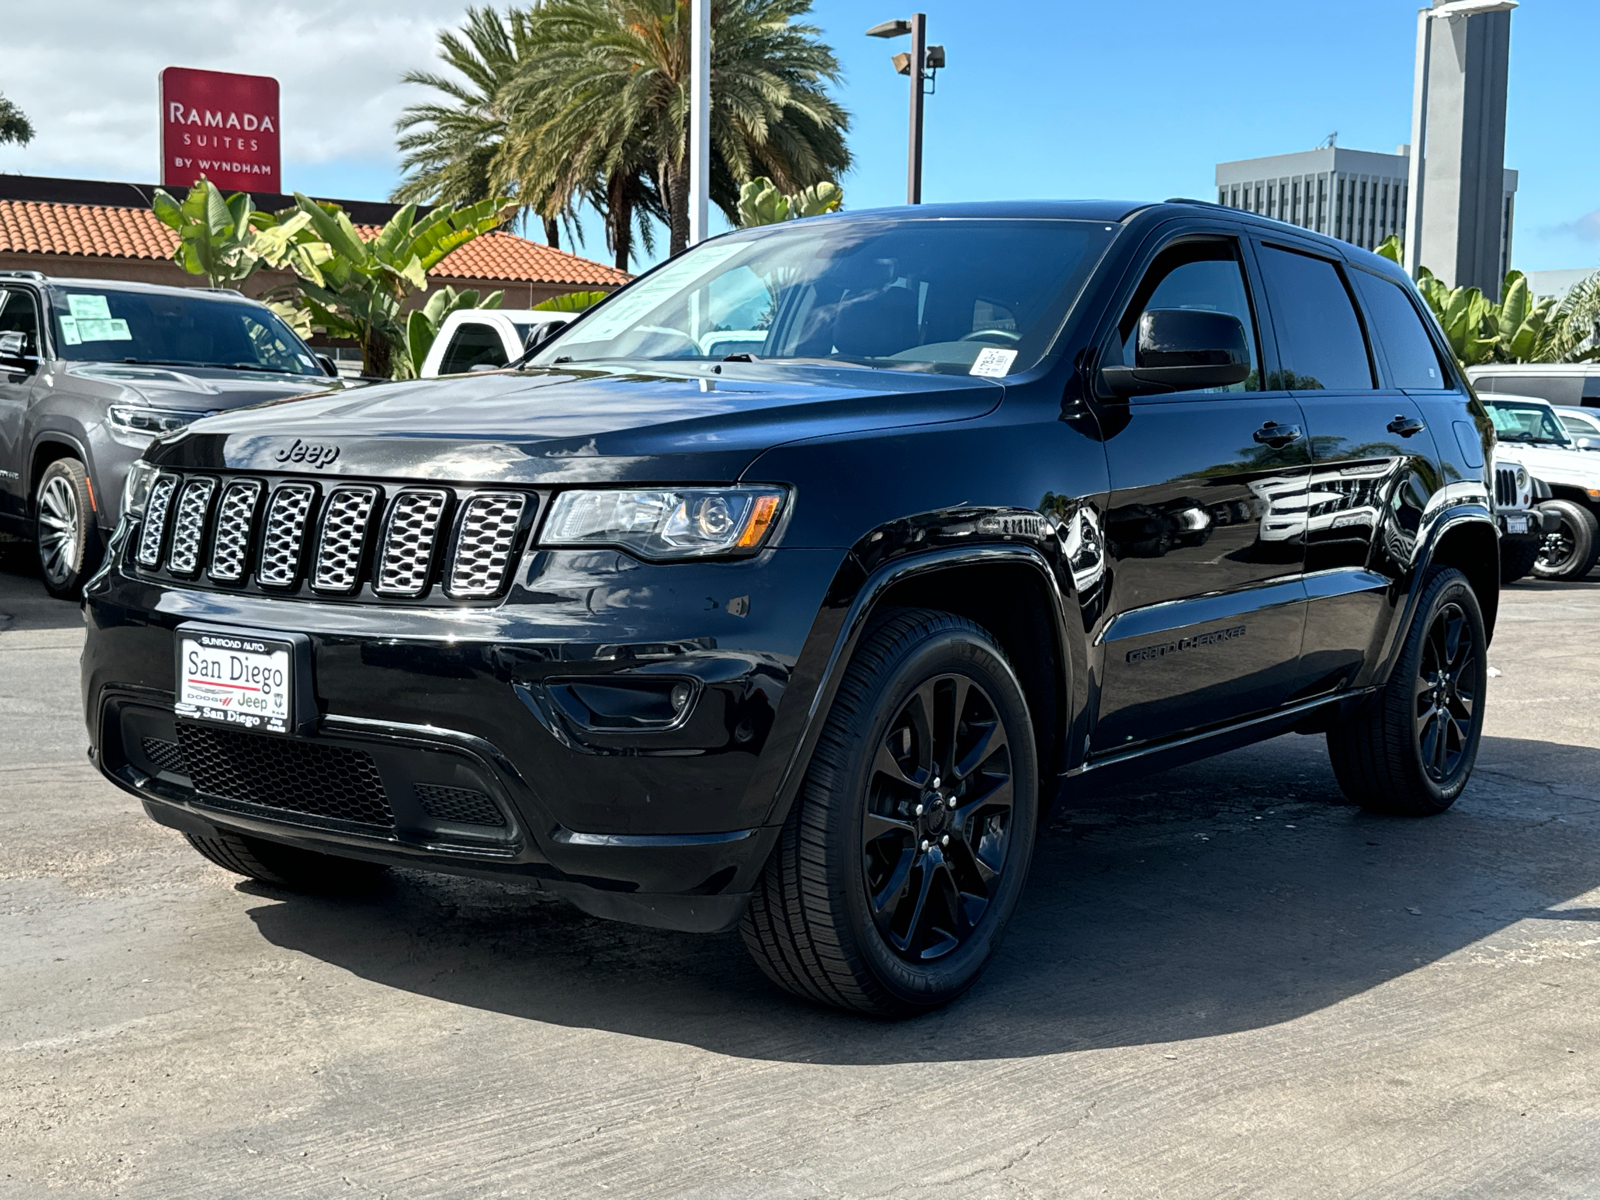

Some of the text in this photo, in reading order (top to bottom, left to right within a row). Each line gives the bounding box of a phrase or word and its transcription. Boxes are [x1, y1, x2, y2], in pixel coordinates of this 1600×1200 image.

[169, 101, 275, 133] RAMADA
[183, 133, 258, 151] SUITES
[174, 157, 271, 175] BY WYNDHAM
[275, 438, 340, 469] Jeep
[201, 637, 265, 652] SUNROAD AUTO
[1126, 625, 1247, 663] GRAND CHEROKEE
[188, 651, 283, 694] San Diego
[237, 692, 268, 711] Jeep
[202, 707, 225, 720] San
[227, 710, 261, 727] Diego
